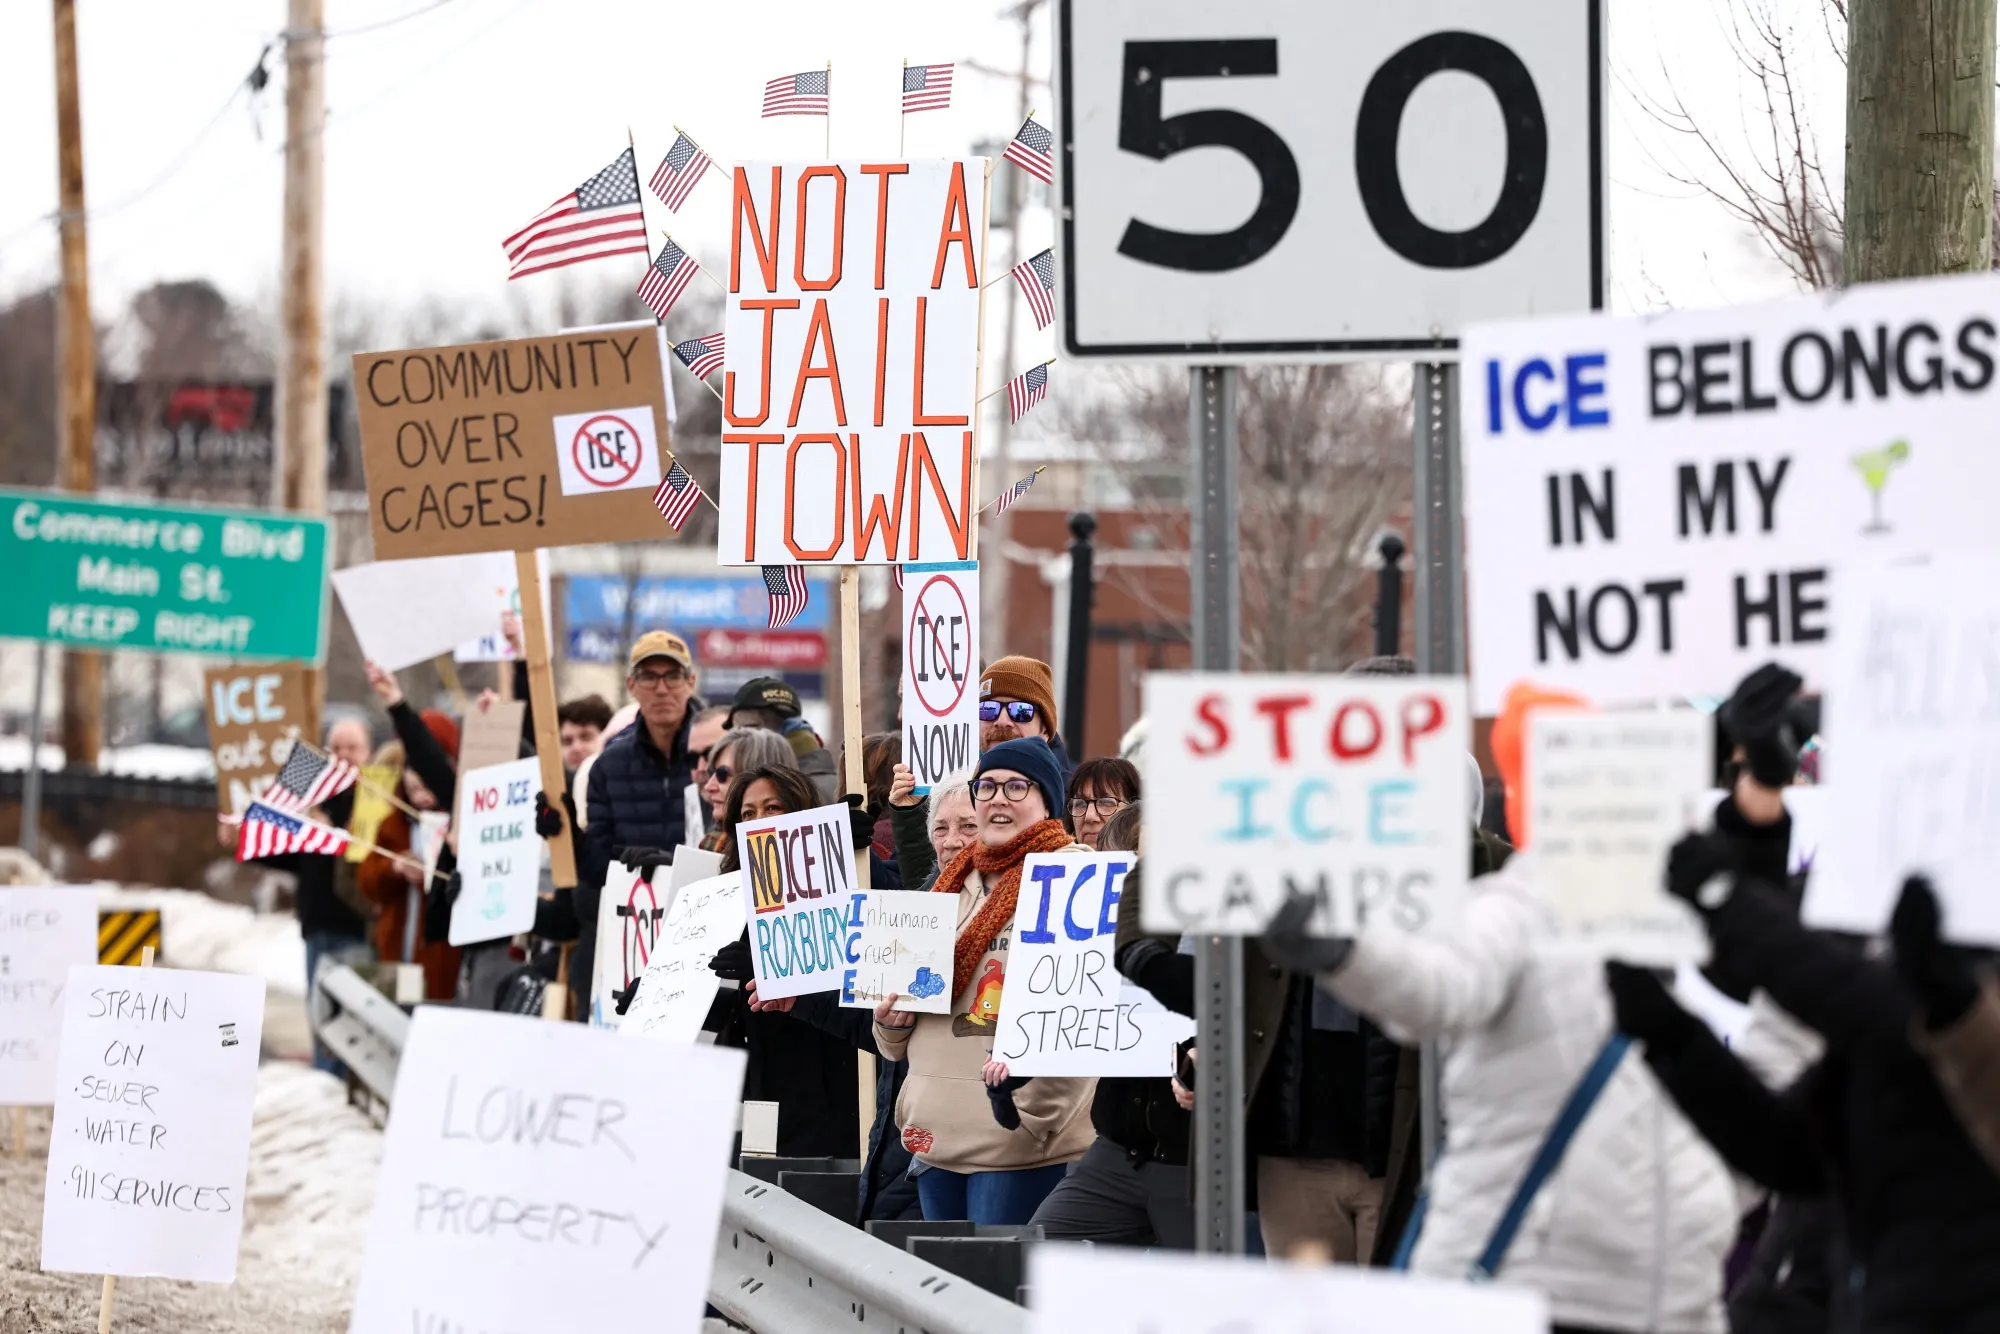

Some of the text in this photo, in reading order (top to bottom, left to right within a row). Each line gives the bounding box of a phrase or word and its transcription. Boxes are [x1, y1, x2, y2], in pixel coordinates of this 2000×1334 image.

[1116, 30, 1548, 273] 50
[730, 162, 978, 293] NOT A
[367, 336, 639, 407] COMMUNITY
[724, 296, 969, 427] JAIL
[1486, 316, 1998, 434] ICE BELONGS
[396, 412, 523, 468] OVER
[587, 430, 628, 469] ICE
[381, 475, 547, 534] CAGES!
[722, 431, 973, 562] TOWN
[1546, 456, 1792, 547] IN MY
[12, 502, 305, 562] Commerce Blvd
[76, 554, 160, 598] Main
[47, 604, 256, 651] KEEP RIGHT
[1534, 566, 1829, 664] NOT HE
[917, 614, 963, 682] ICE
[212, 673, 286, 728] ICE
[1183, 692, 1448, 766] STOP
[473, 779, 530, 813] NO ICE
[1213, 776, 1424, 845] ICE
[746, 819, 848, 908] NO ICE IN
[848, 893, 939, 931] Inhumane
[1020, 862, 1128, 944] ICE
[1163, 866, 1434, 933] CAMPS
[756, 904, 850, 980] ROXBURY
[845, 931, 898, 966] Cruel
[1028, 949, 1106, 997] OUR
[88, 988, 187, 1021] STRAIN
[842, 968, 884, 1004] Evil
[104, 1040, 144, 1067] ON
[1003, 1002, 1142, 1059] STREETS
[80, 1075, 160, 1115] SEWER
[441, 1073, 636, 1164] LOWER
[85, 1117, 168, 1151] WATER
[414, 1181, 671, 1271] PROPERTY
